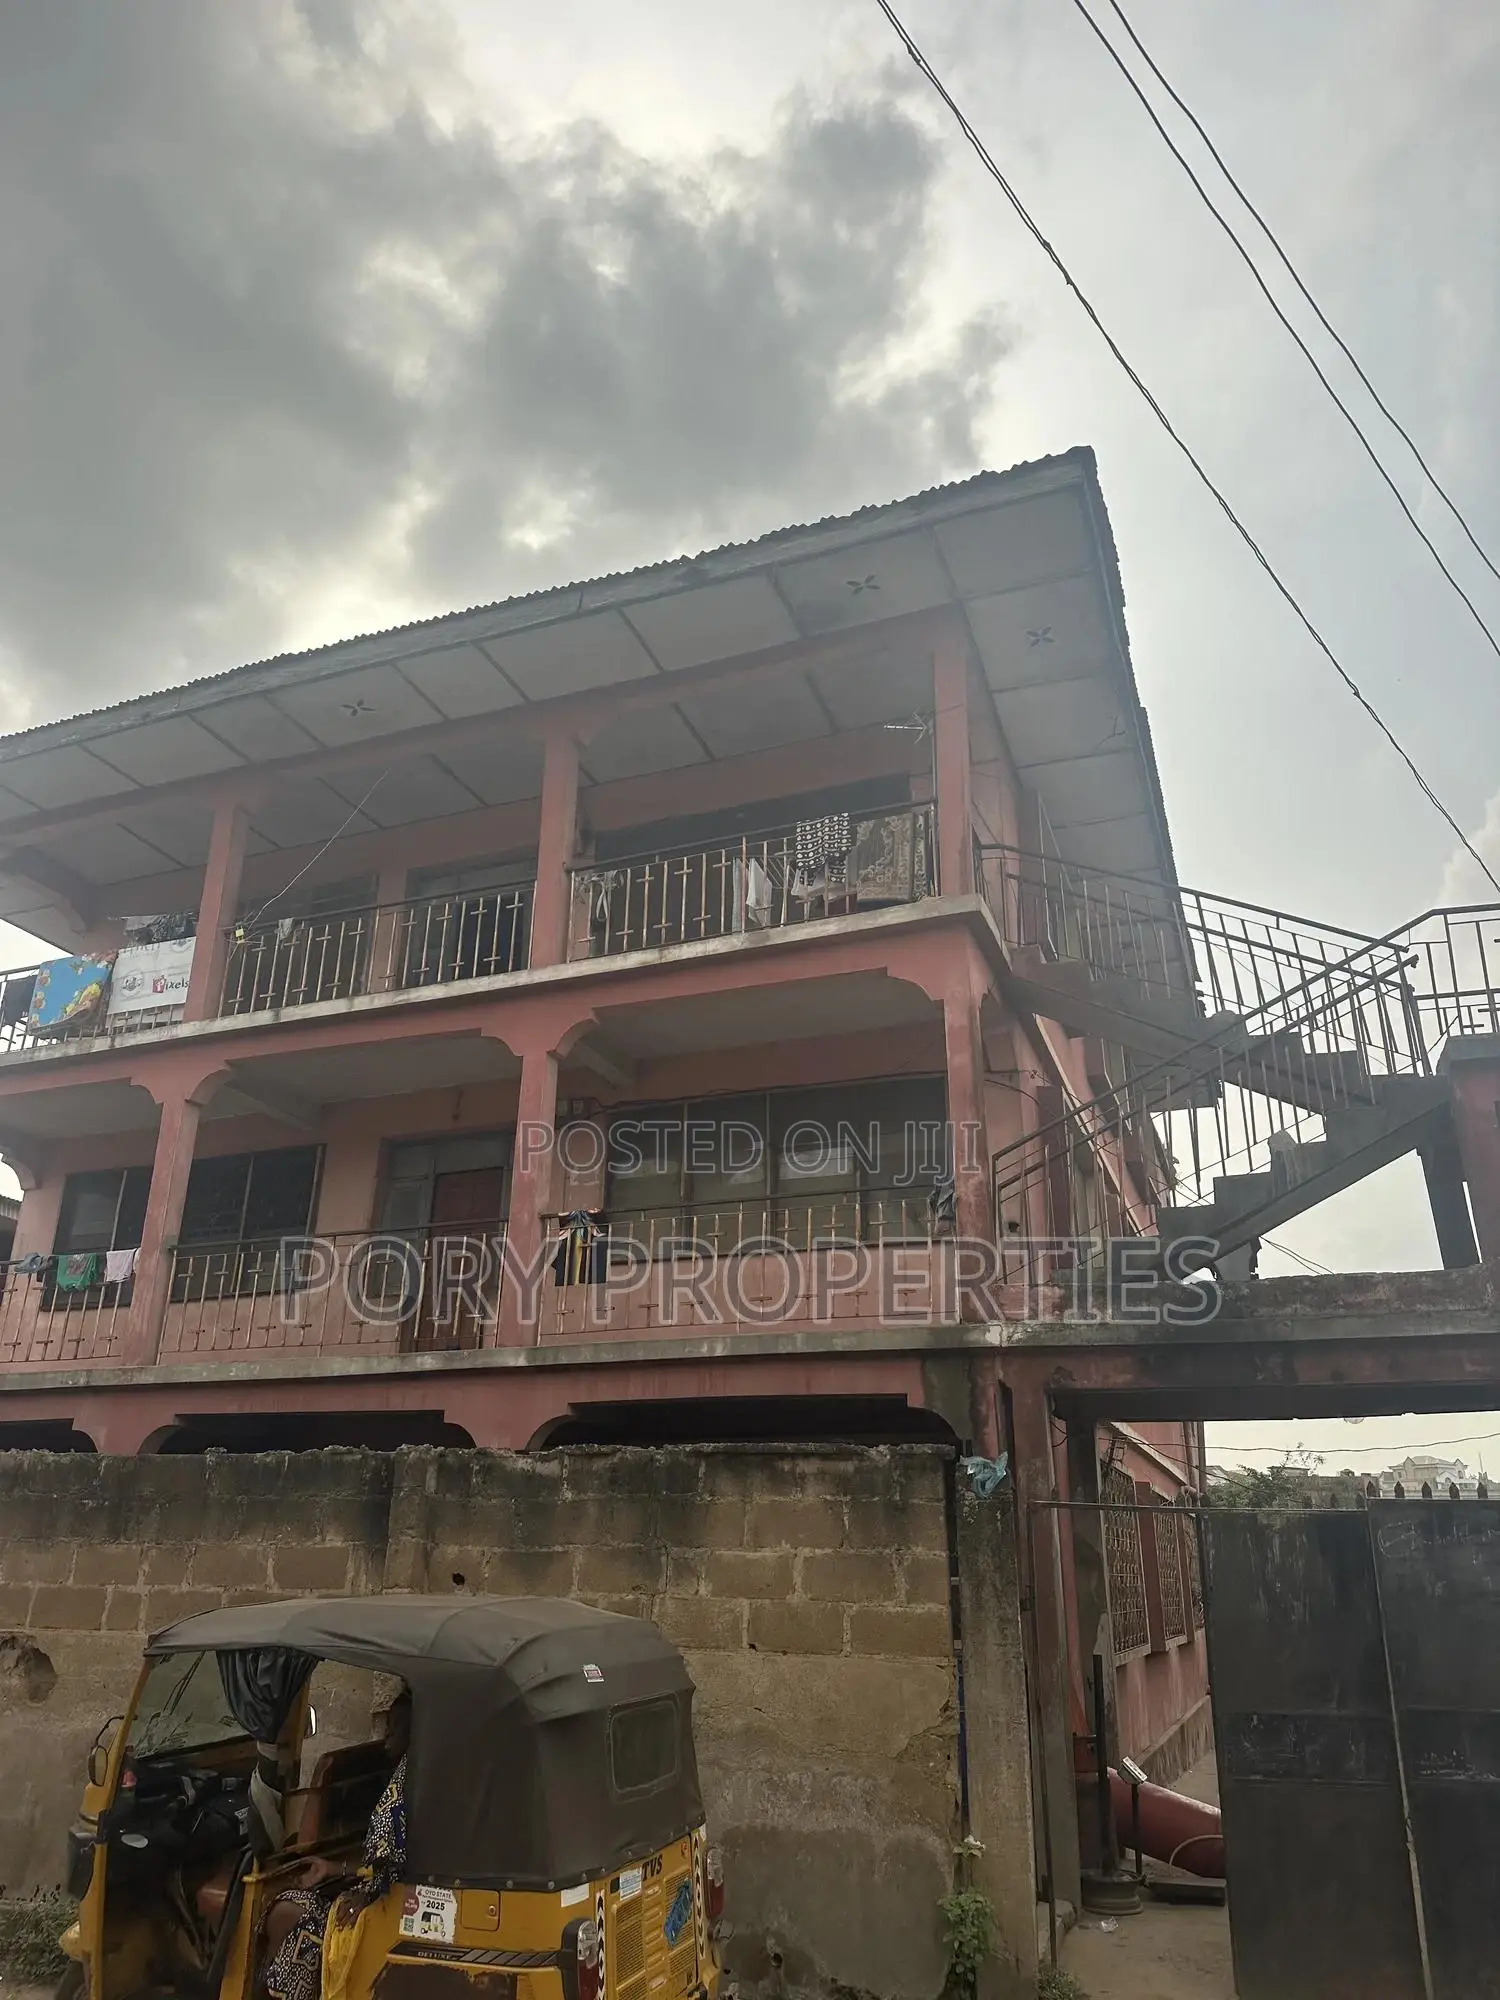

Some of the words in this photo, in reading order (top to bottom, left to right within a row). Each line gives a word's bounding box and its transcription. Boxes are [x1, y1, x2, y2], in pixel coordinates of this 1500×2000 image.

[642, 1854, 663, 1881] TVS
[436, 1891, 452, 1899] STATE
[426, 1900, 445, 1910] 2025
